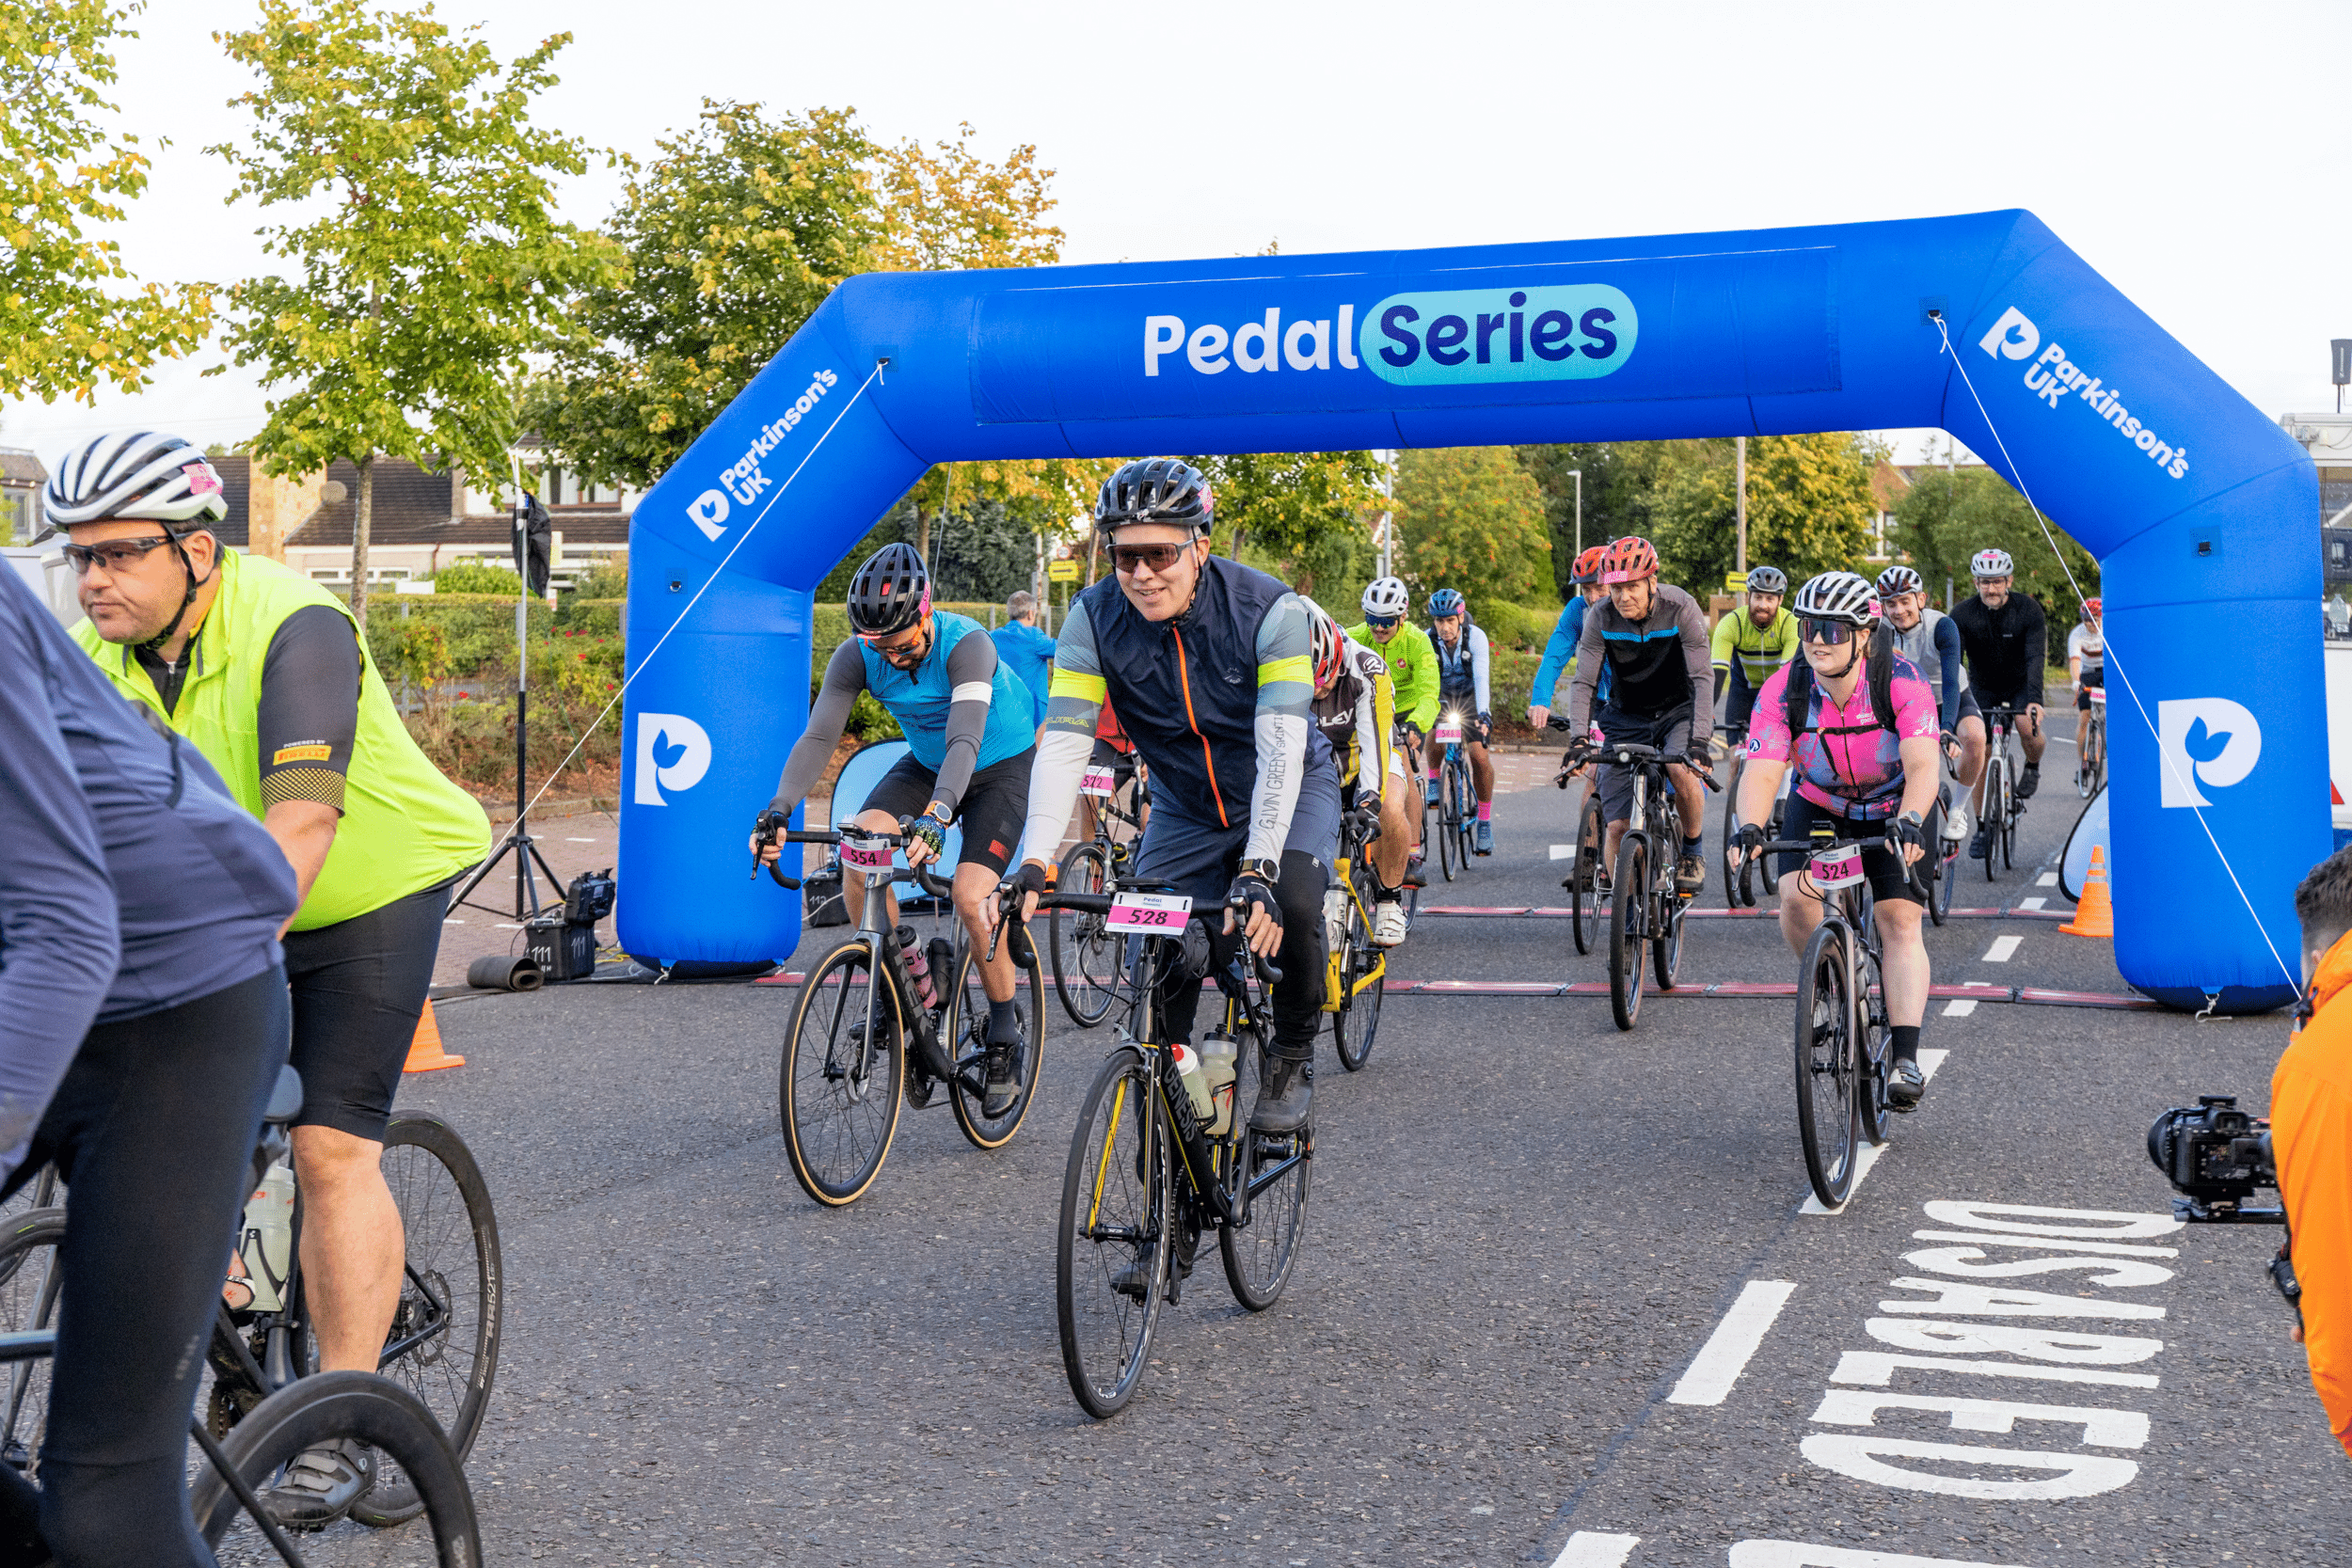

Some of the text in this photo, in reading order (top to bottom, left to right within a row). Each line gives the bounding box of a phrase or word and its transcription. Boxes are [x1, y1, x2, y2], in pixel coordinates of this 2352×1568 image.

[1144, 291, 1618, 376] Pedal Series
[2024, 361, 2070, 409] UK
[2038, 341, 2189, 480] Parkinson's
[719, 369, 837, 492] Parkinson's
[732, 467, 772, 505] UK
[1083, 775, 1103, 788] 522
[1266, 752, 1286, 790] GREEN
[850, 848, 877, 865] 554
[1821, 862, 1849, 880] 524
[1128, 909, 1168, 926] 528
[532, 945, 551, 962] 111
[1164, 1062, 1199, 1143] GENESIS
[1800, 1200, 2185, 1501] DISABLED
